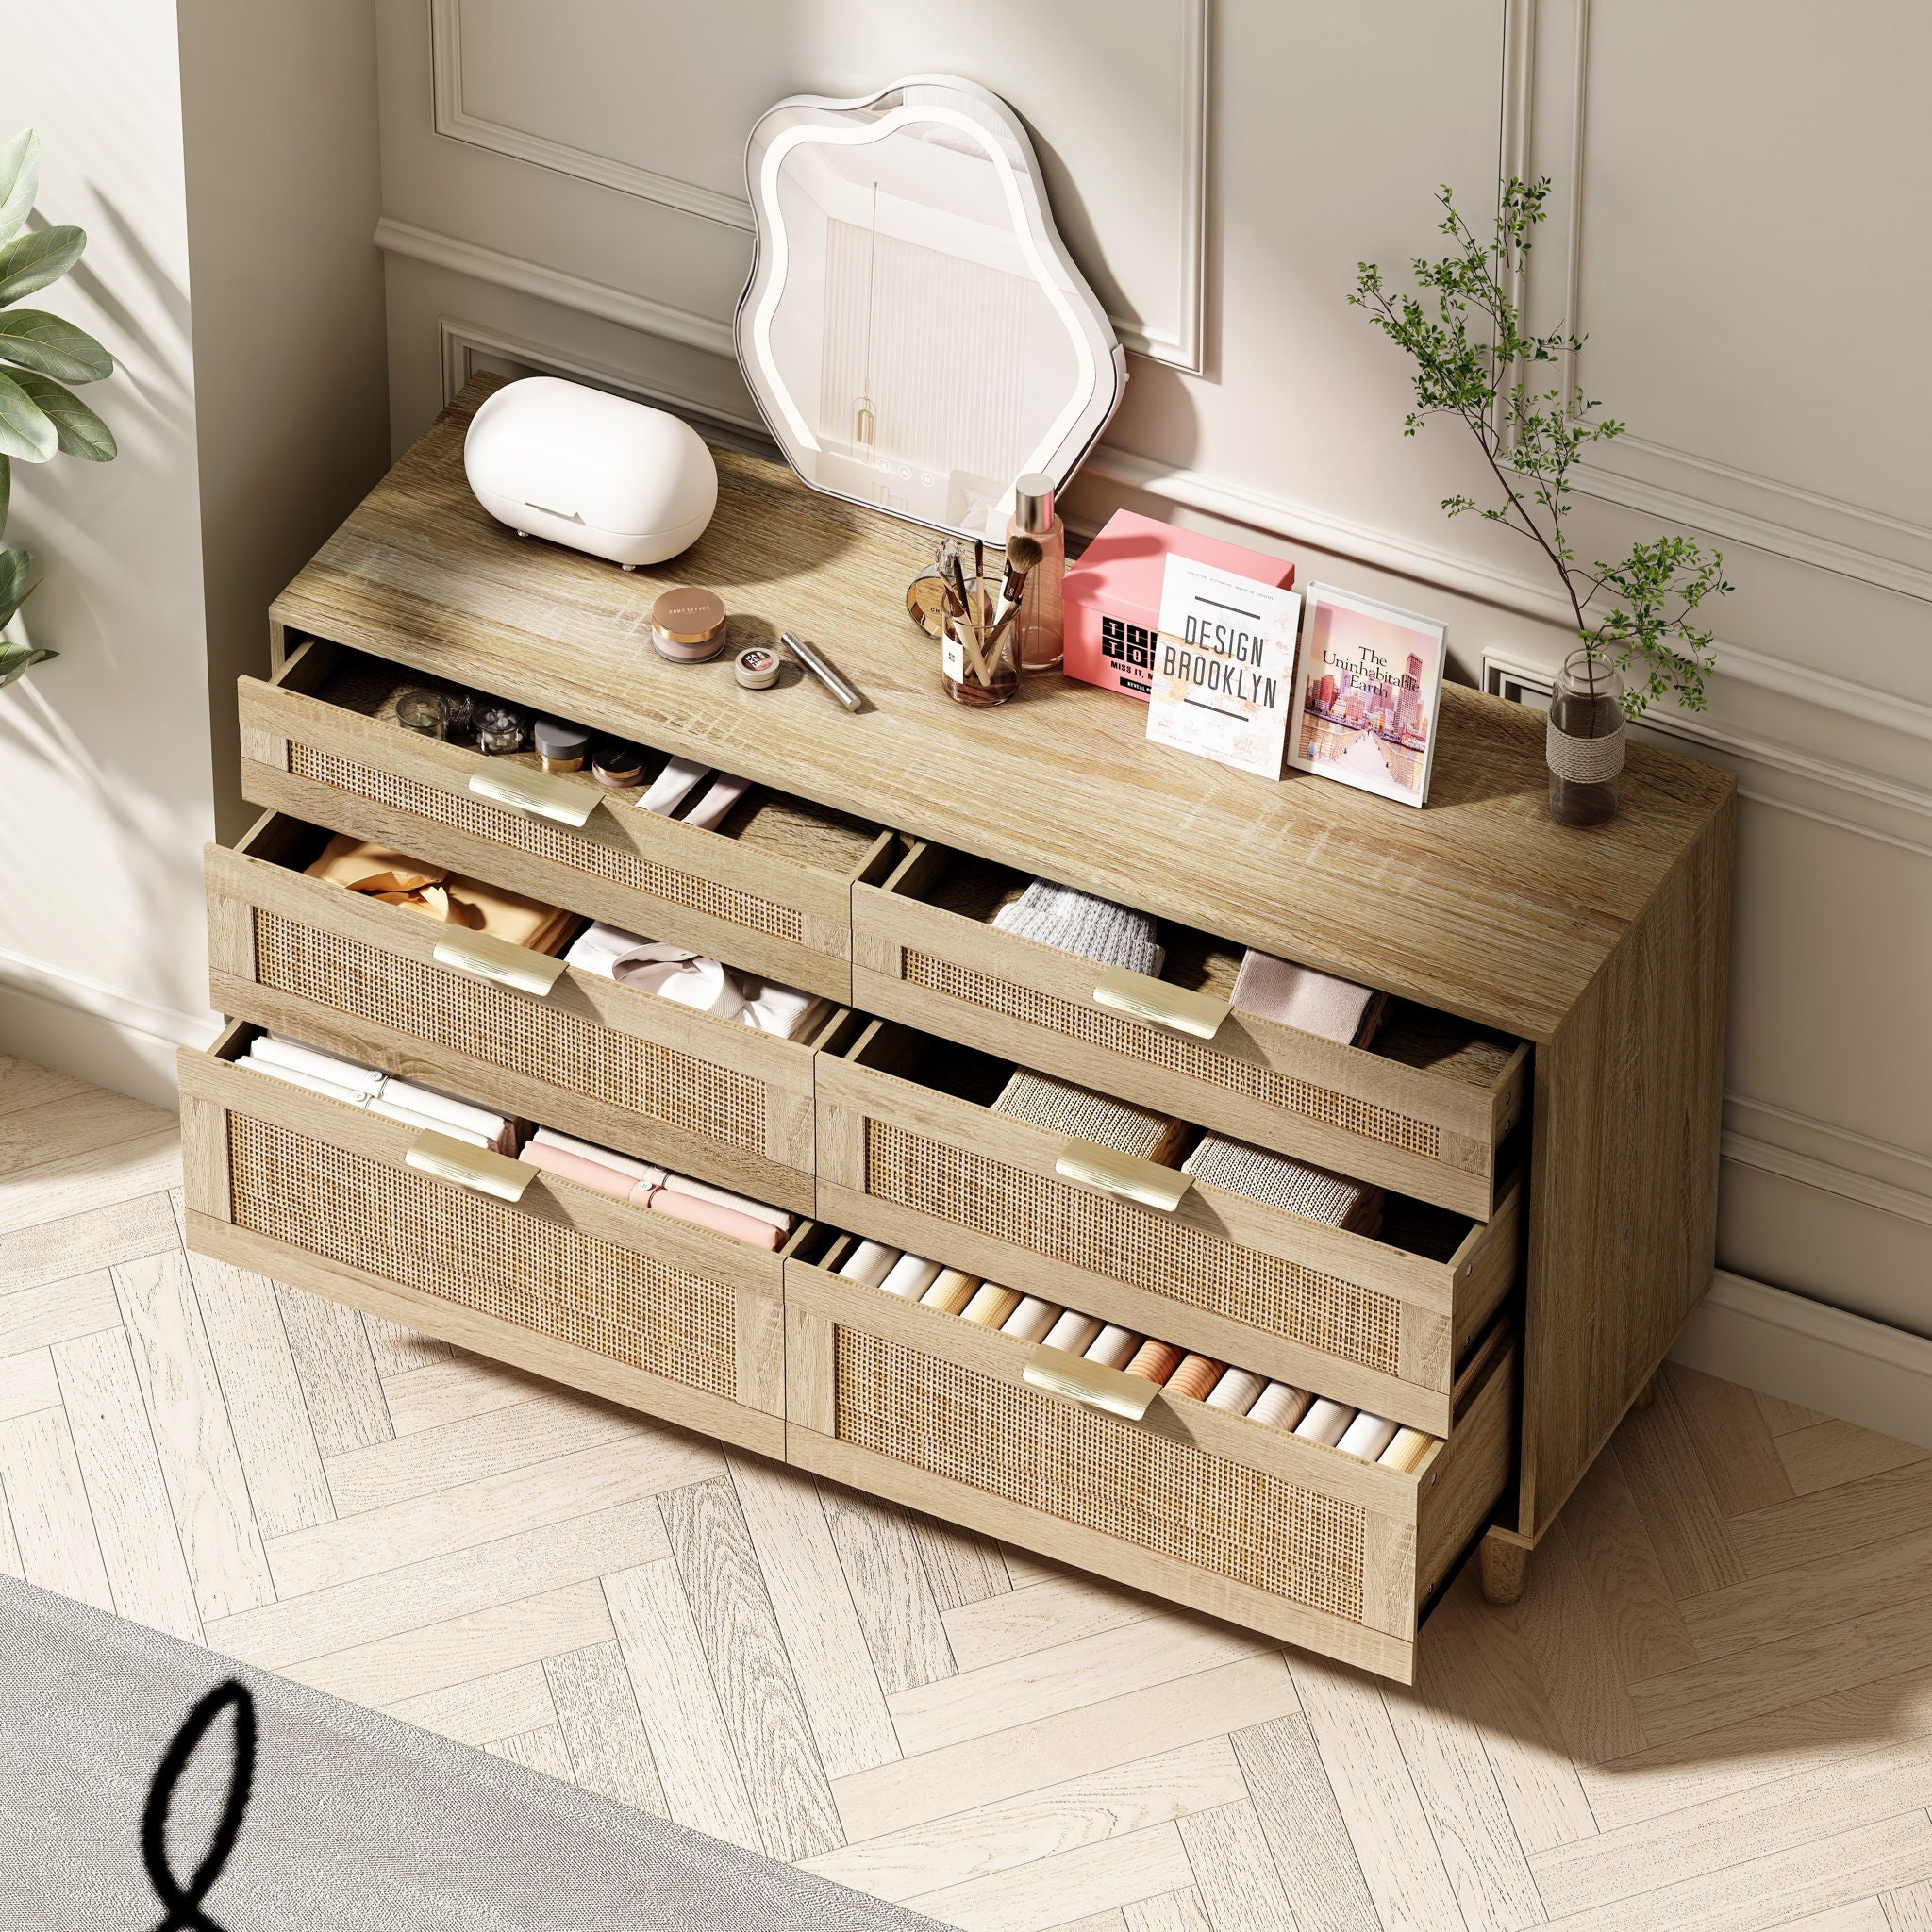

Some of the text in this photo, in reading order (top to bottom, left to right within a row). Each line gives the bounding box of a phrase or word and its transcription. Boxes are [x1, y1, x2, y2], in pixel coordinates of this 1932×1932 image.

[1185, 615, 1264, 668] DESIGN
[1358, 645, 1388, 667] The
[1110, 660, 1132, 674] MISS
[1134, 668, 1144, 678] IT,
[1163, 647, 1276, 709] BROOKLYN
[1322, 649, 1420, 692] Uninhabitable
[1350, 675, 1388, 698] Earth
